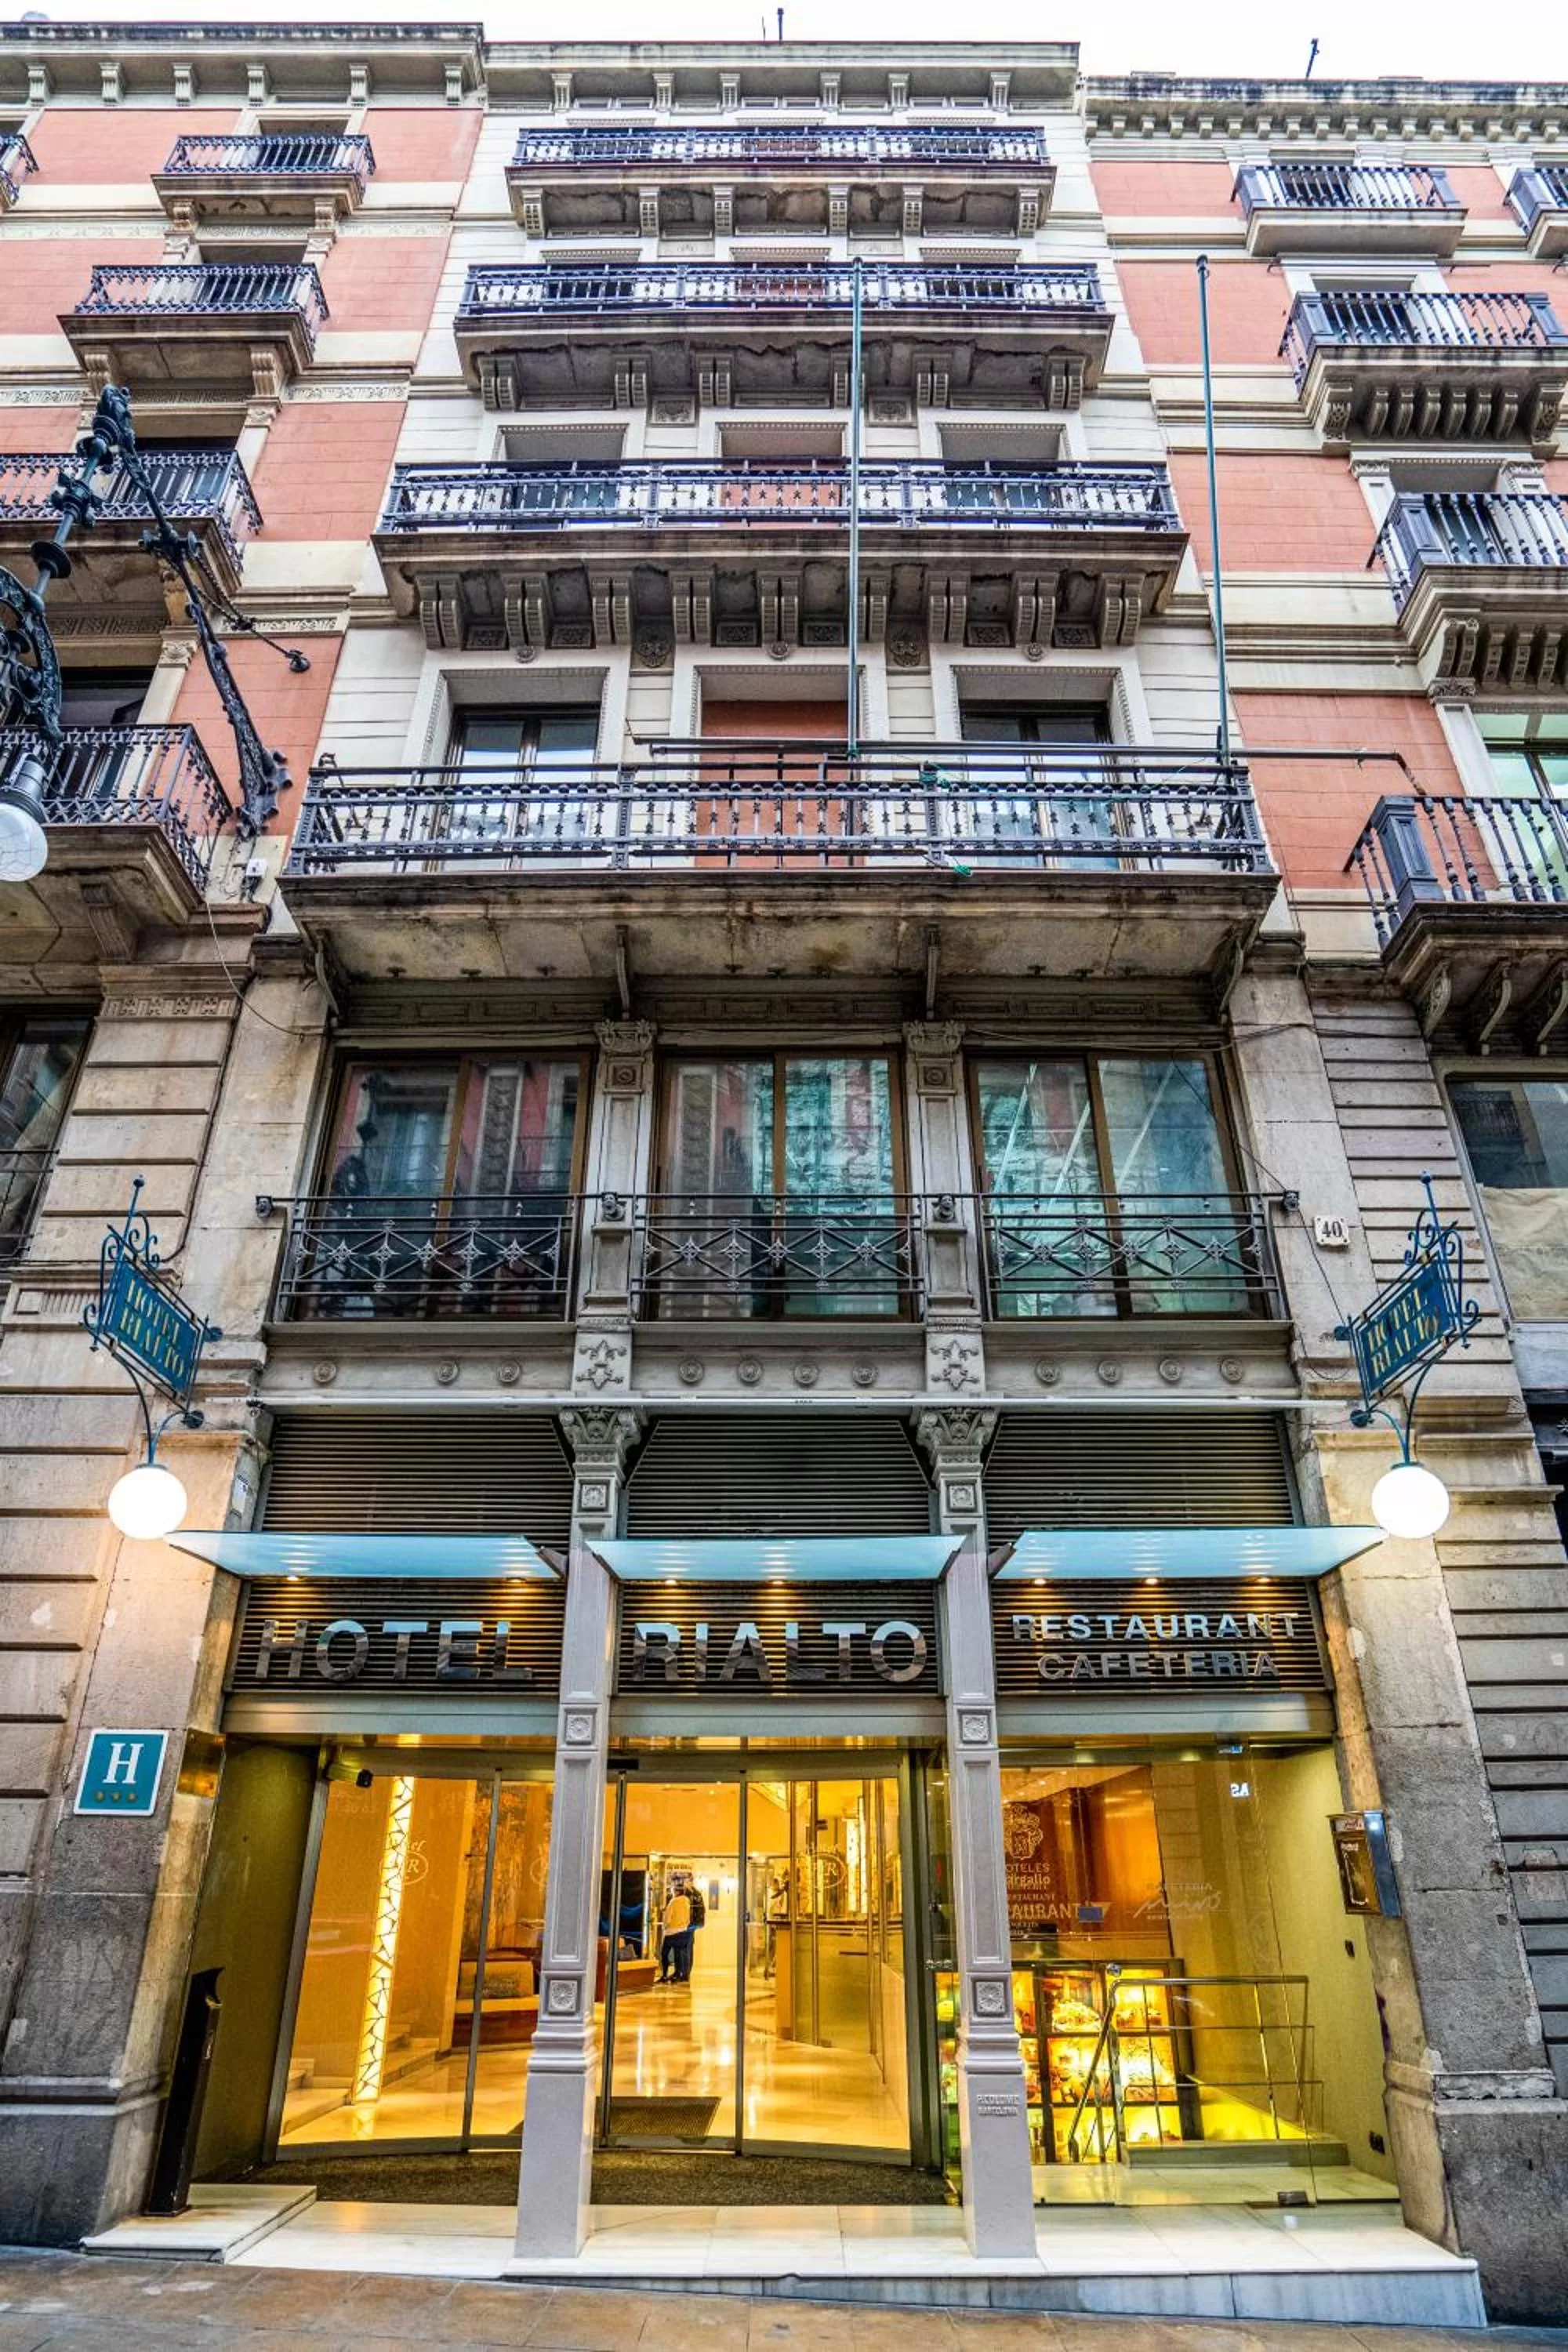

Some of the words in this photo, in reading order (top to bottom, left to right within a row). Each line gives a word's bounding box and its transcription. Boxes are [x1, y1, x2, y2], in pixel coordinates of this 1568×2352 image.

[1322, 1221, 1342, 1237] 40
[126, 1279, 181, 1345] HOTEL
[1367, 1287, 1428, 1353] HOTEL
[120, 1307, 185, 1378] RIALTO
[1371, 1310, 1439, 1377] RIALTO
[1011, 1613, 1299, 1641] RESTAURANT
[255, 1619, 533, 1680] HOTEL
[632, 1621, 927, 1682] RIALTO
[1037, 1650, 1280, 1680] CAFETERIA
[101, 1742, 145, 1784] H
[1006, 1862, 1051, 1873] OTELES
[1006, 1873, 1051, 1886] argallo
